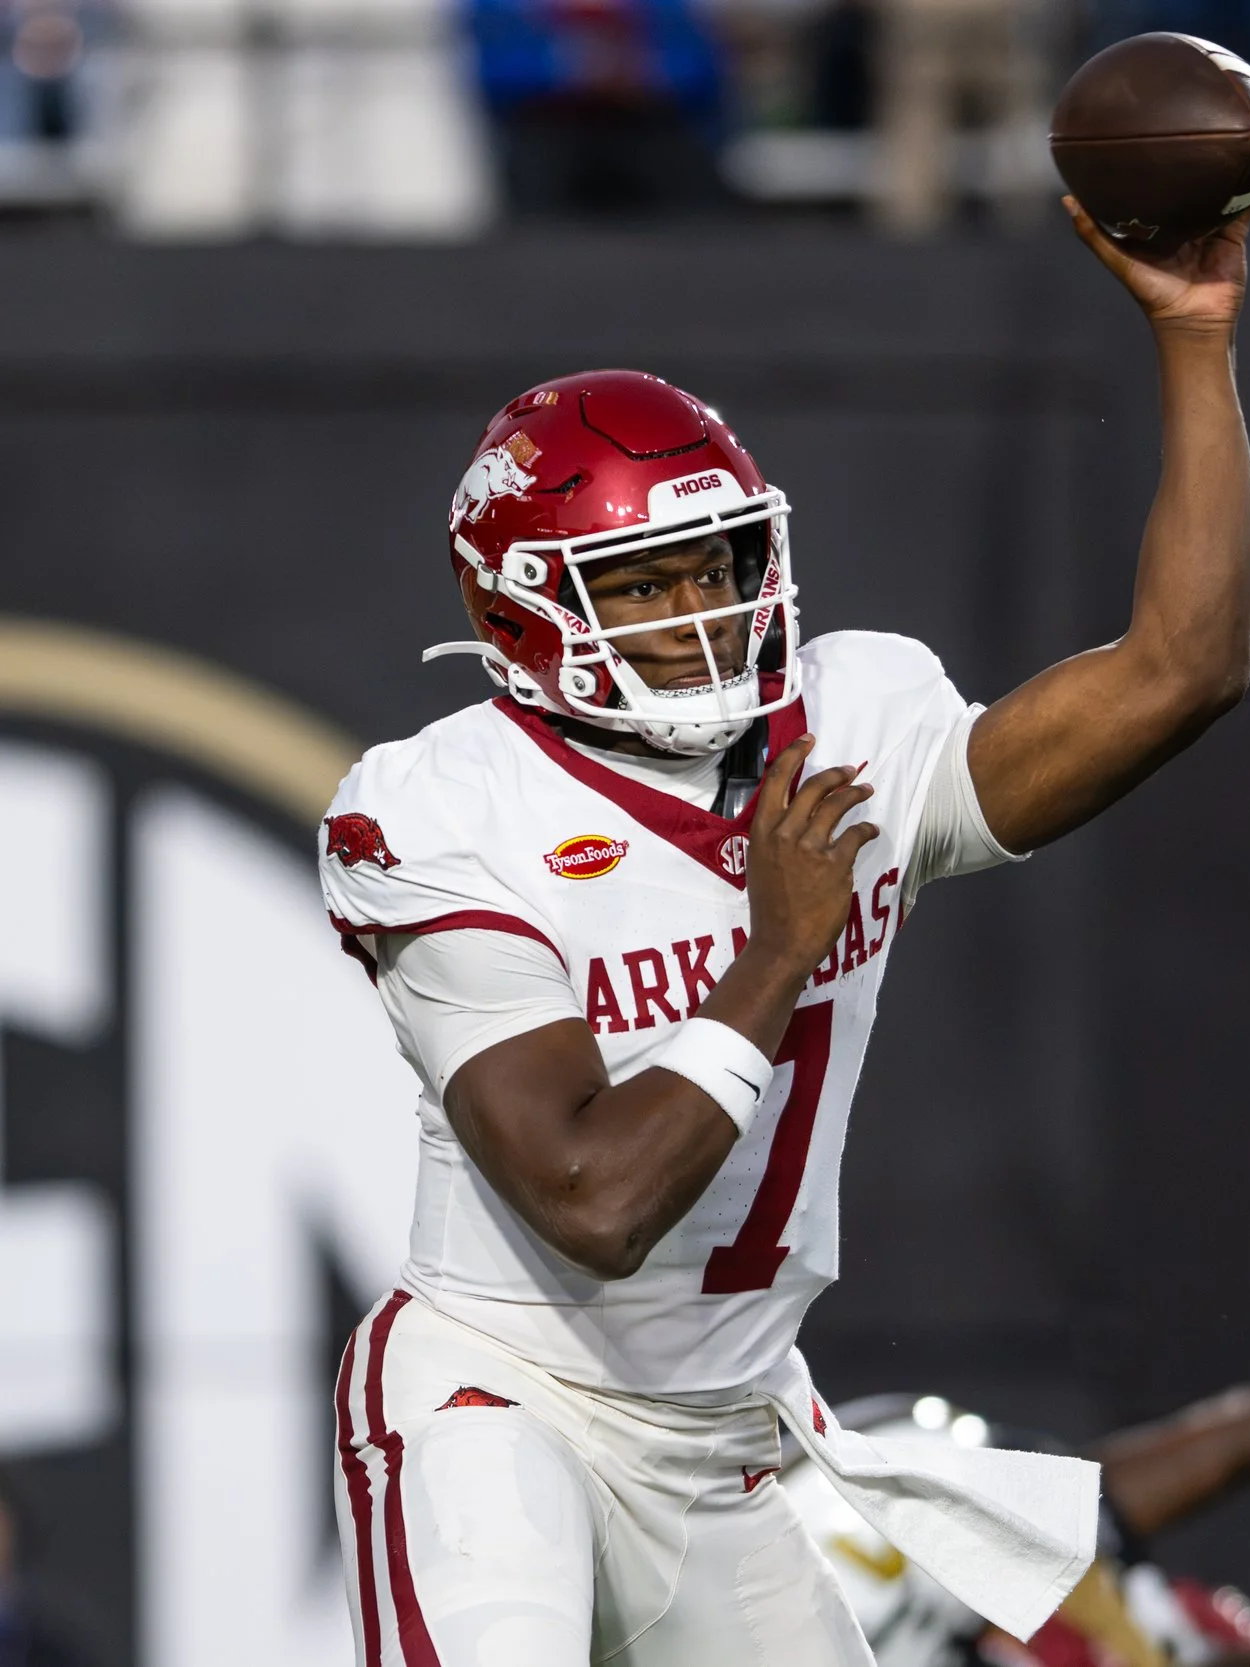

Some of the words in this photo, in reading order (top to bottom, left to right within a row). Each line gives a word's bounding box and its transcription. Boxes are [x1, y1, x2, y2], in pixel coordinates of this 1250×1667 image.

[672, 474, 722, 498] HOGS
[586, 867, 899, 1035] ARKAS
[701, 999, 834, 1294] 7
